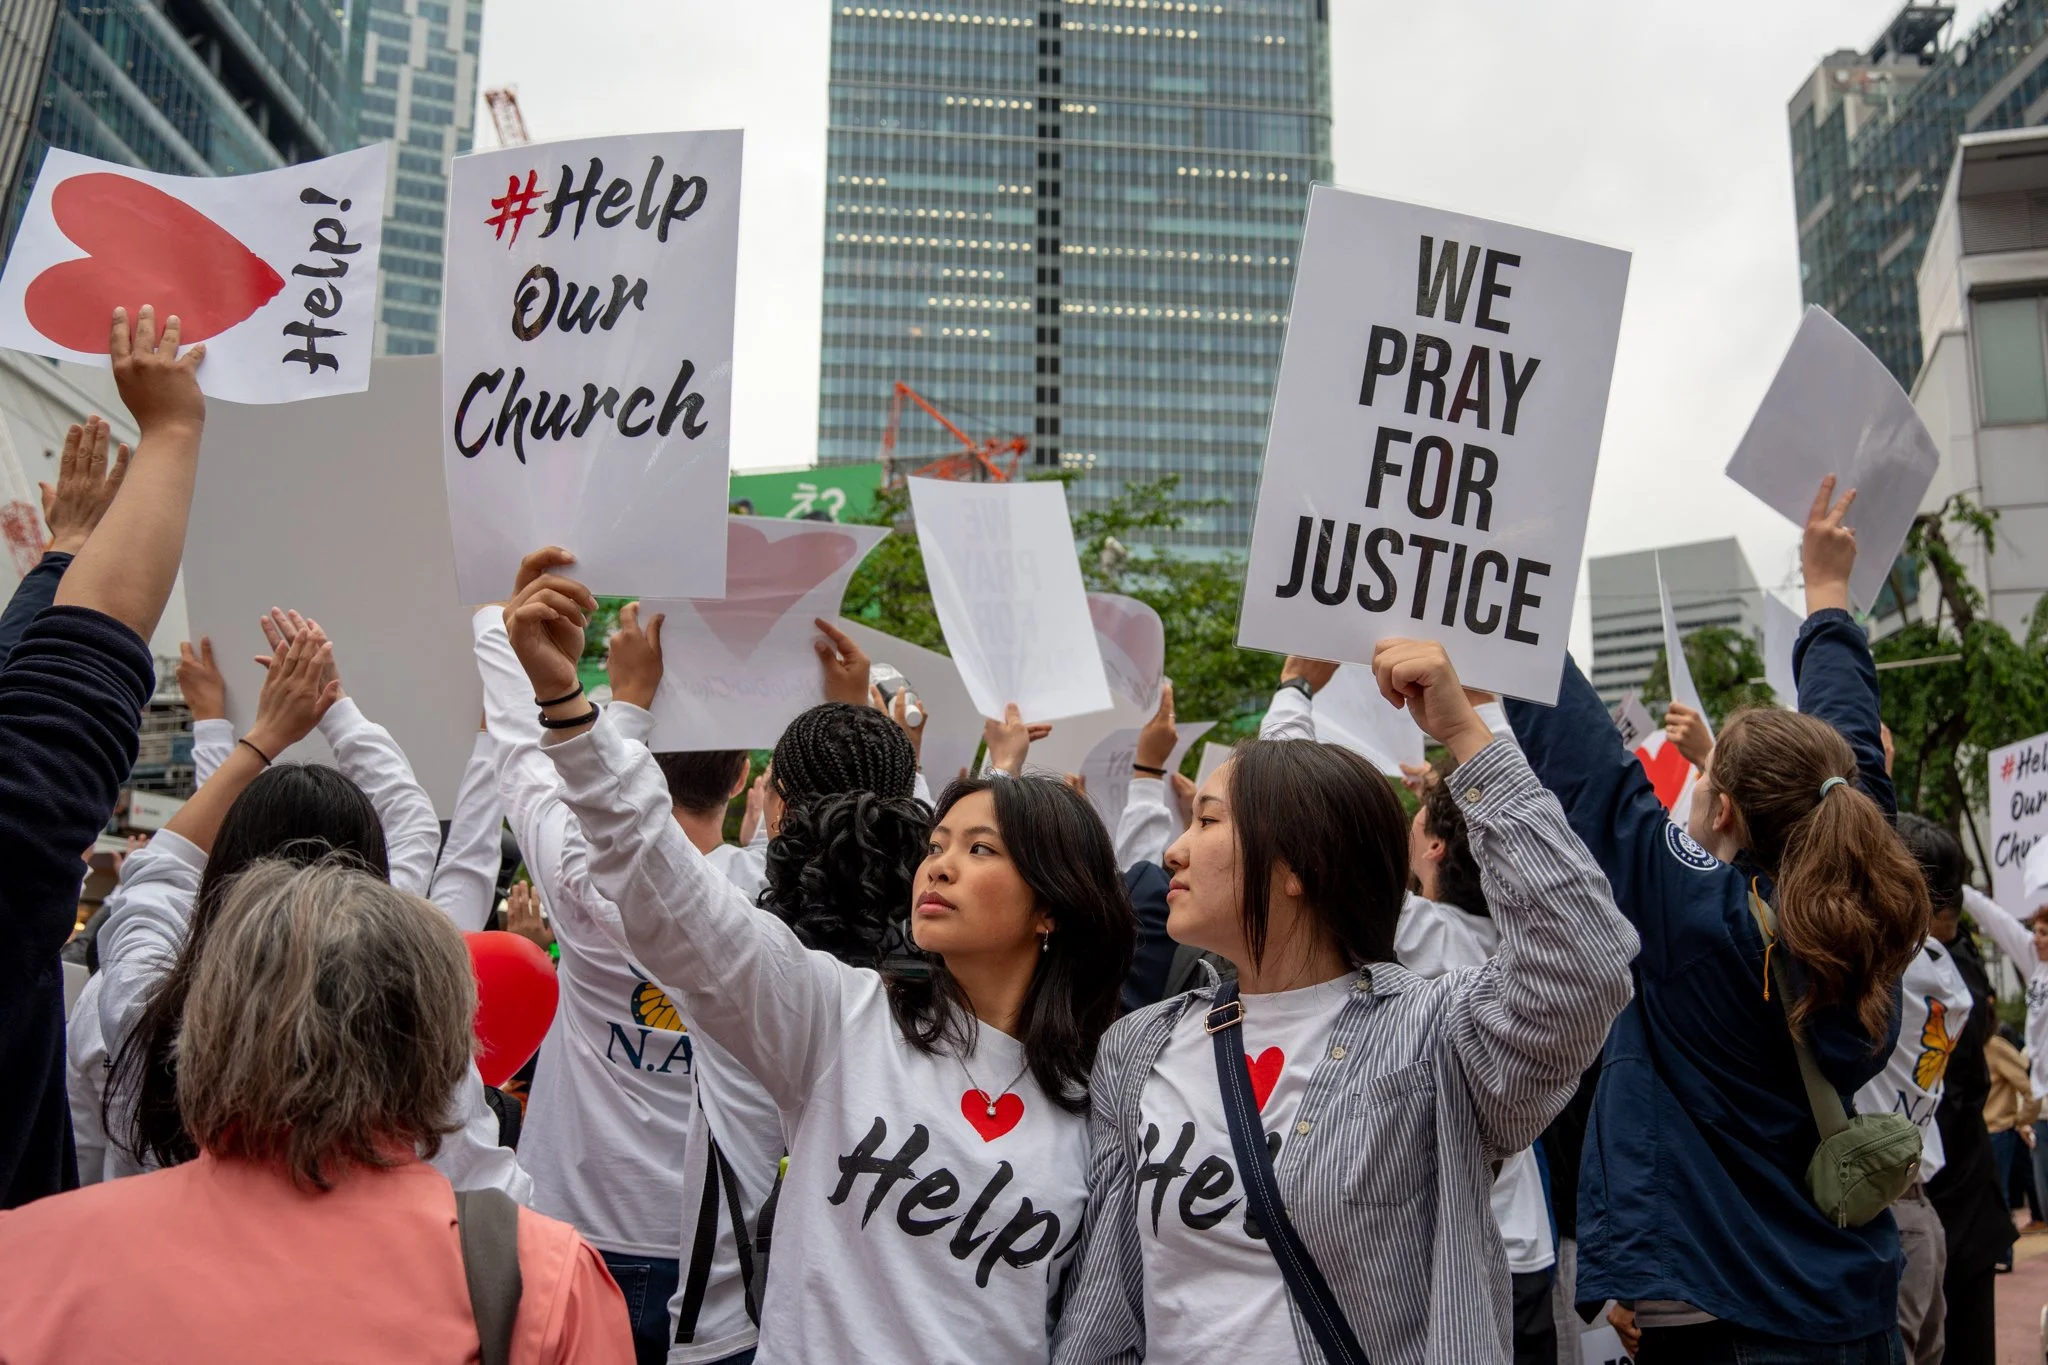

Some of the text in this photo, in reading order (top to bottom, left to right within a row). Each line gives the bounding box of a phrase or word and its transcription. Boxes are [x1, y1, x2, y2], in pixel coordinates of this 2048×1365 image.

[485, 156, 708, 249] #Help
[282, 188, 362, 374] Help!
[512, 265, 648, 342] Our
[1415, 235, 1522, 334] WE
[454, 359, 709, 465] Church
[1359, 325, 1541, 436] PRAY
[1365, 426, 1499, 532] FOR
[1275, 516, 1552, 646] JUSTICE
[2001, 741, 2048, 783] #Hel
[2010, 791, 2048, 820] Our
[1995, 831, 2042, 868] Chu
